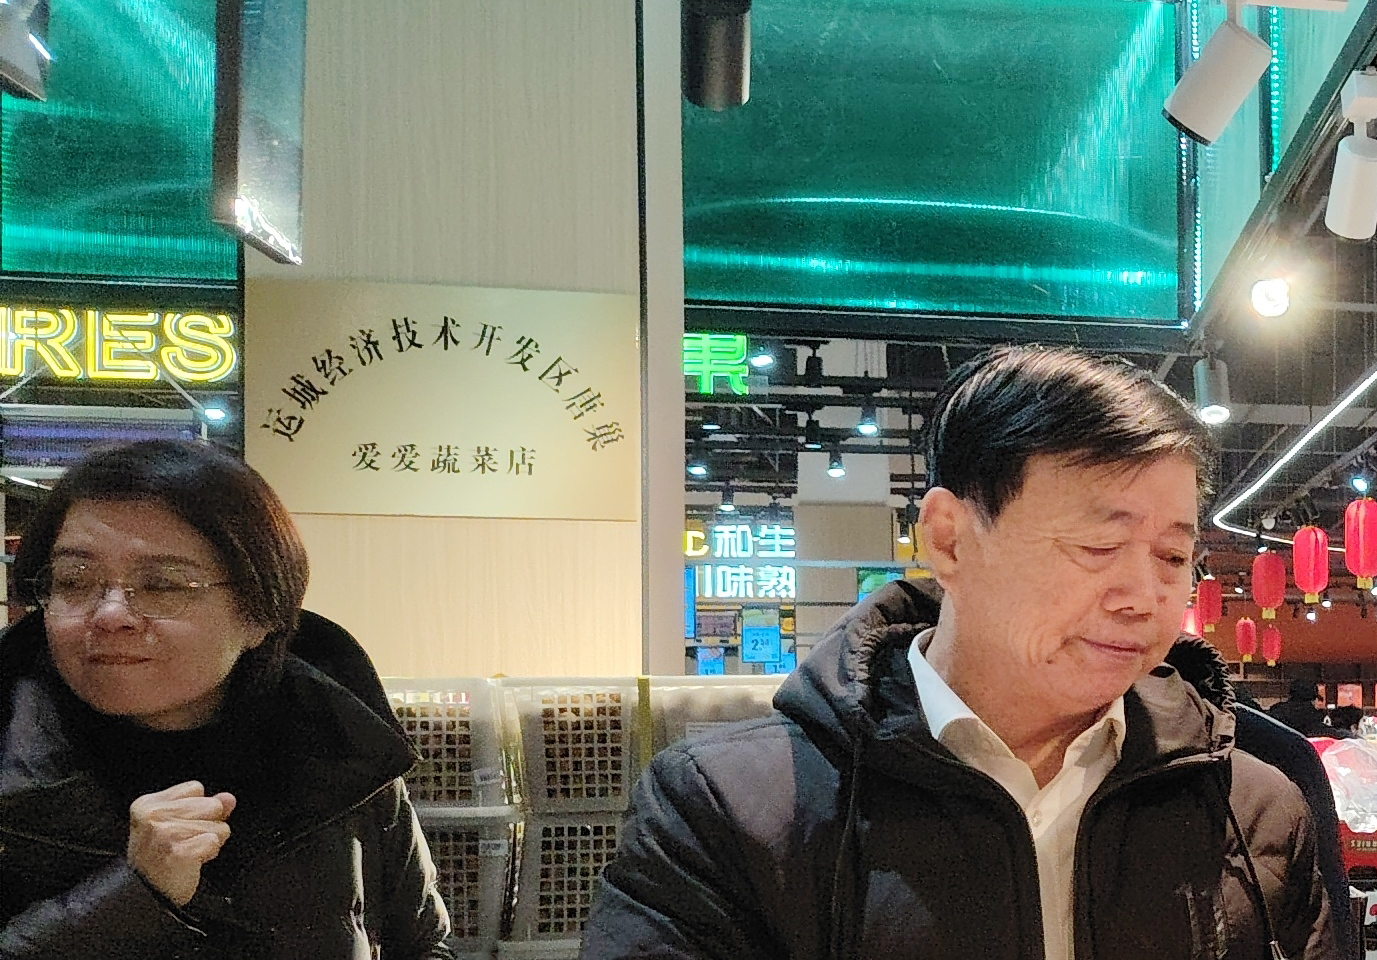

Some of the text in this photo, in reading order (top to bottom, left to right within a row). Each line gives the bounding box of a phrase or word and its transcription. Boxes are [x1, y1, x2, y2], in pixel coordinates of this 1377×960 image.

[0, 307, 238, 382] RES
[350, 442, 538, 477] 爱爱蔬菜店
[713, 524, 796, 558] 和生
